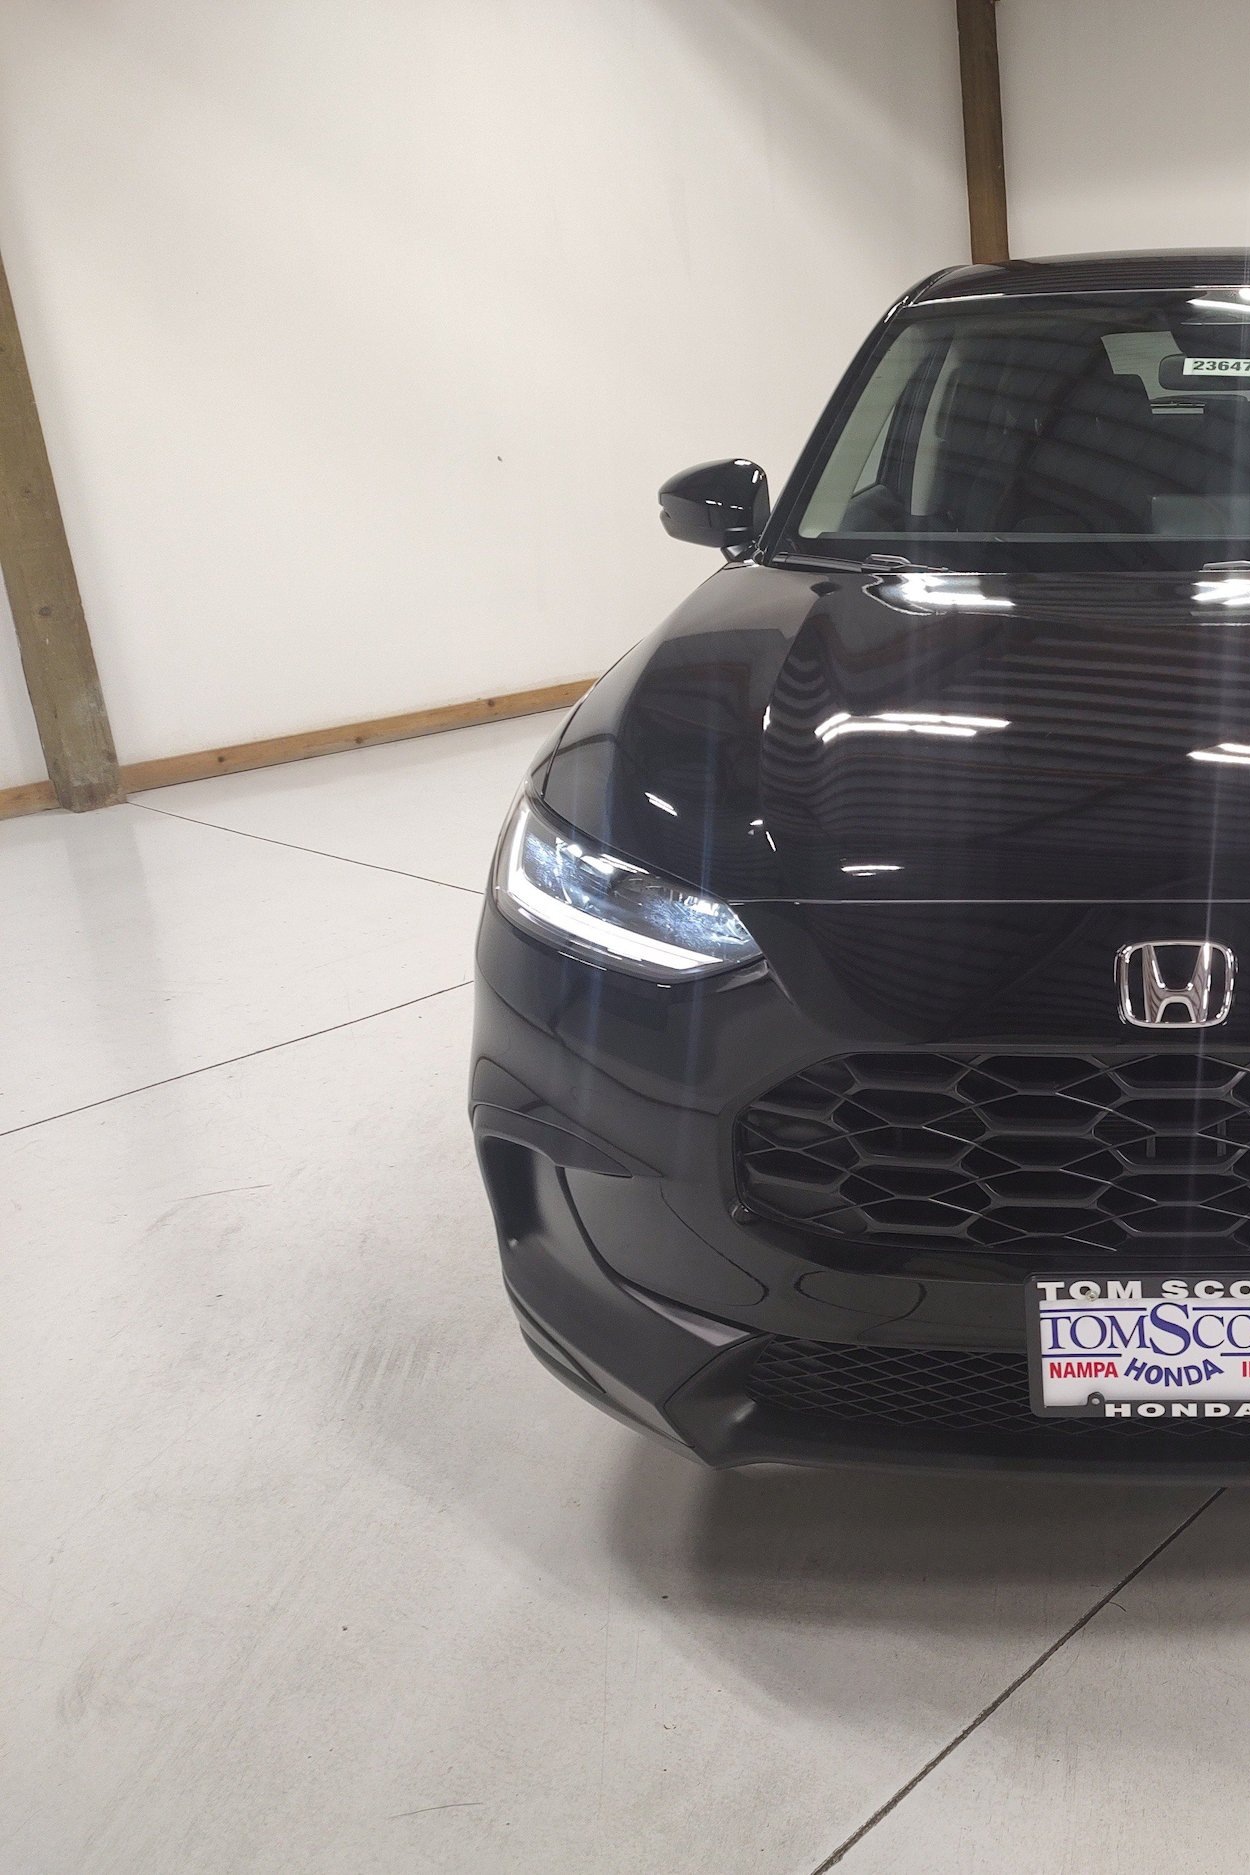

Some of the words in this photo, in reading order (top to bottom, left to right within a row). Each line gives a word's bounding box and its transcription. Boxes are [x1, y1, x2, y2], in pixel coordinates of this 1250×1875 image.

[1037, 1281, 1142, 1301] TOM
[1050, 1362, 1118, 1378] NAMPA
[1124, 1357, 1224, 1387] HONDA
